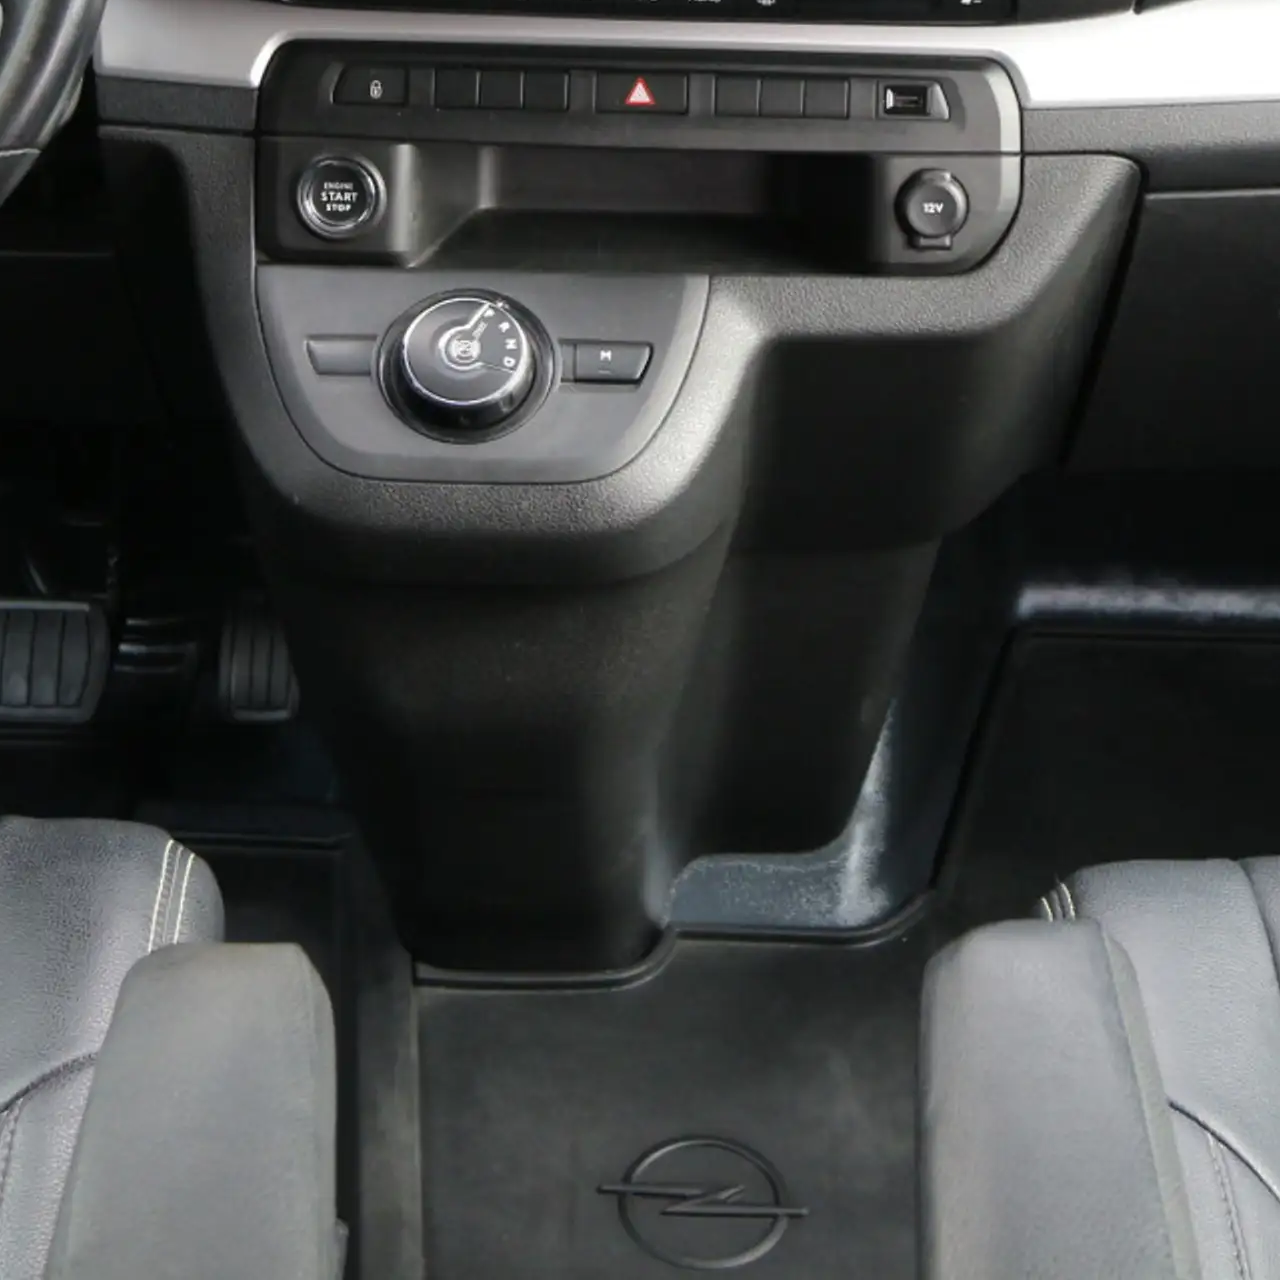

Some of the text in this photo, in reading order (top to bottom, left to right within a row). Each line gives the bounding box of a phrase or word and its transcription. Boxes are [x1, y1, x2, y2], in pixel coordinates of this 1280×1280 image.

[320, 191, 358, 203] START
[325, 203, 352, 212] STOP
[923, 202, 944, 214] 12V
[505, 338, 518, 350] N
[503, 355, 516, 368] D
